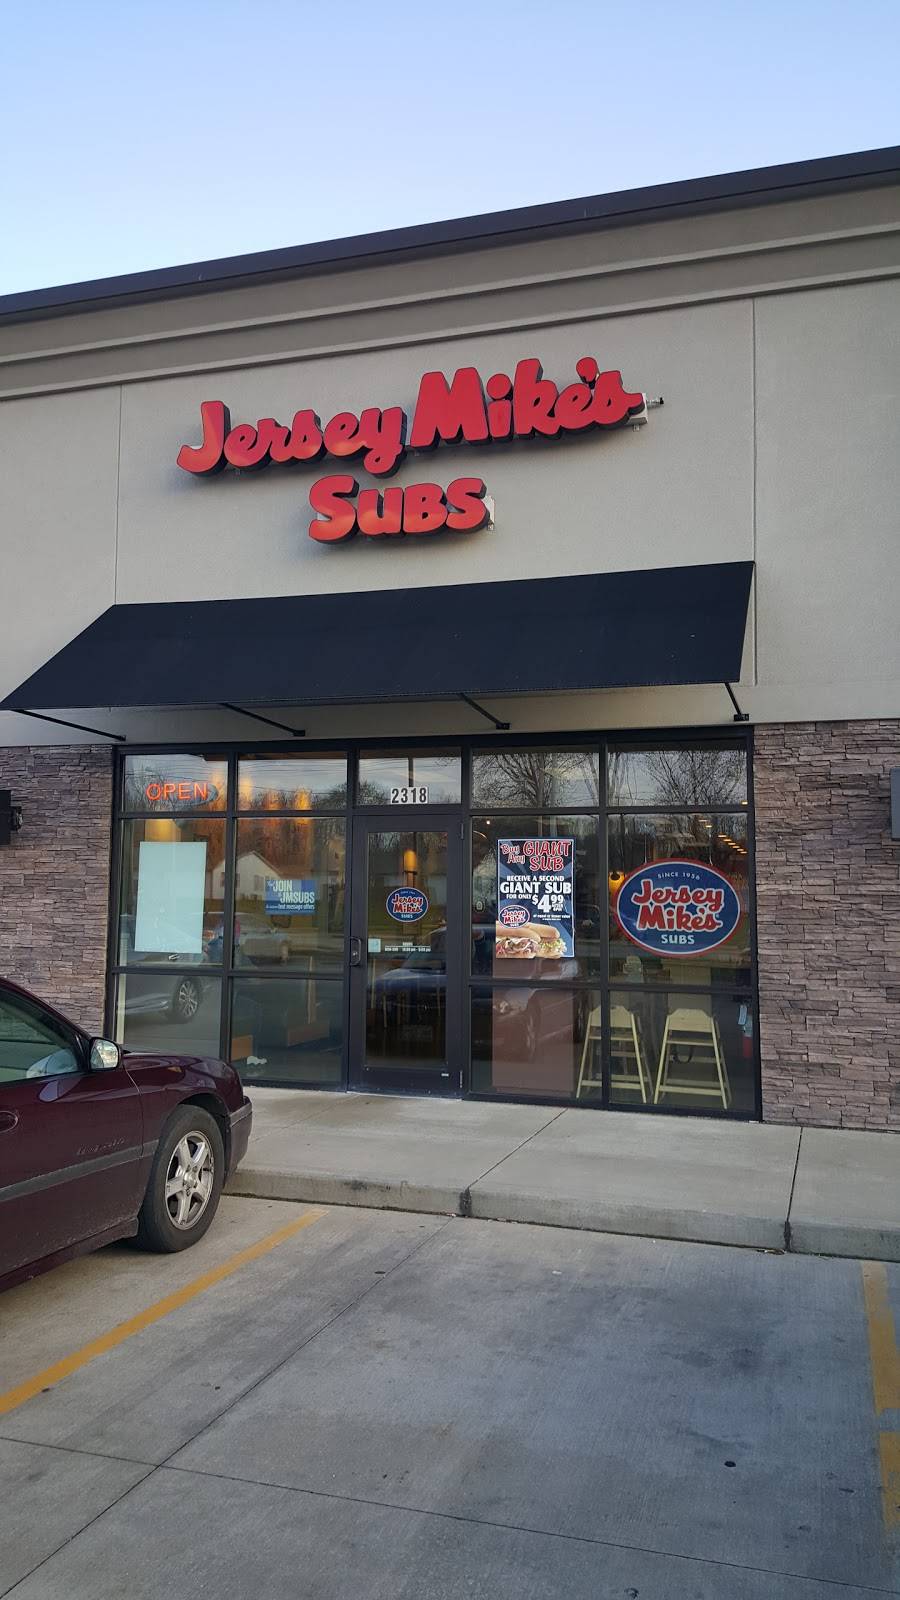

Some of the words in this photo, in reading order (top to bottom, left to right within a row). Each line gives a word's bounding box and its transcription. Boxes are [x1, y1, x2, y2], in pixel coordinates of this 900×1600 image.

[177, 401, 406, 477] Jersey
[410, 357, 645, 448] Mike's
[146, 781, 208, 801] OPEN
[391, 787, 427, 804] 2318
[523, 840, 571, 856] GIANT
[507, 853, 525, 864] Any
[529, 856, 564, 871] SUB
[682, 872, 700, 880] 1956
[272, 880, 293, 892] JOIN
[500, 882, 541, 894] GIANT
[545, 882, 572, 894] SUB
[280, 891, 315, 904] JMSUBS
[392, 893, 424, 907] Jersey
[631, 879, 725, 912] Jersey
[502, 909, 526, 920] Jersey
[636, 905, 724, 932] Mike's
[661, 934, 695, 945] SUBS
